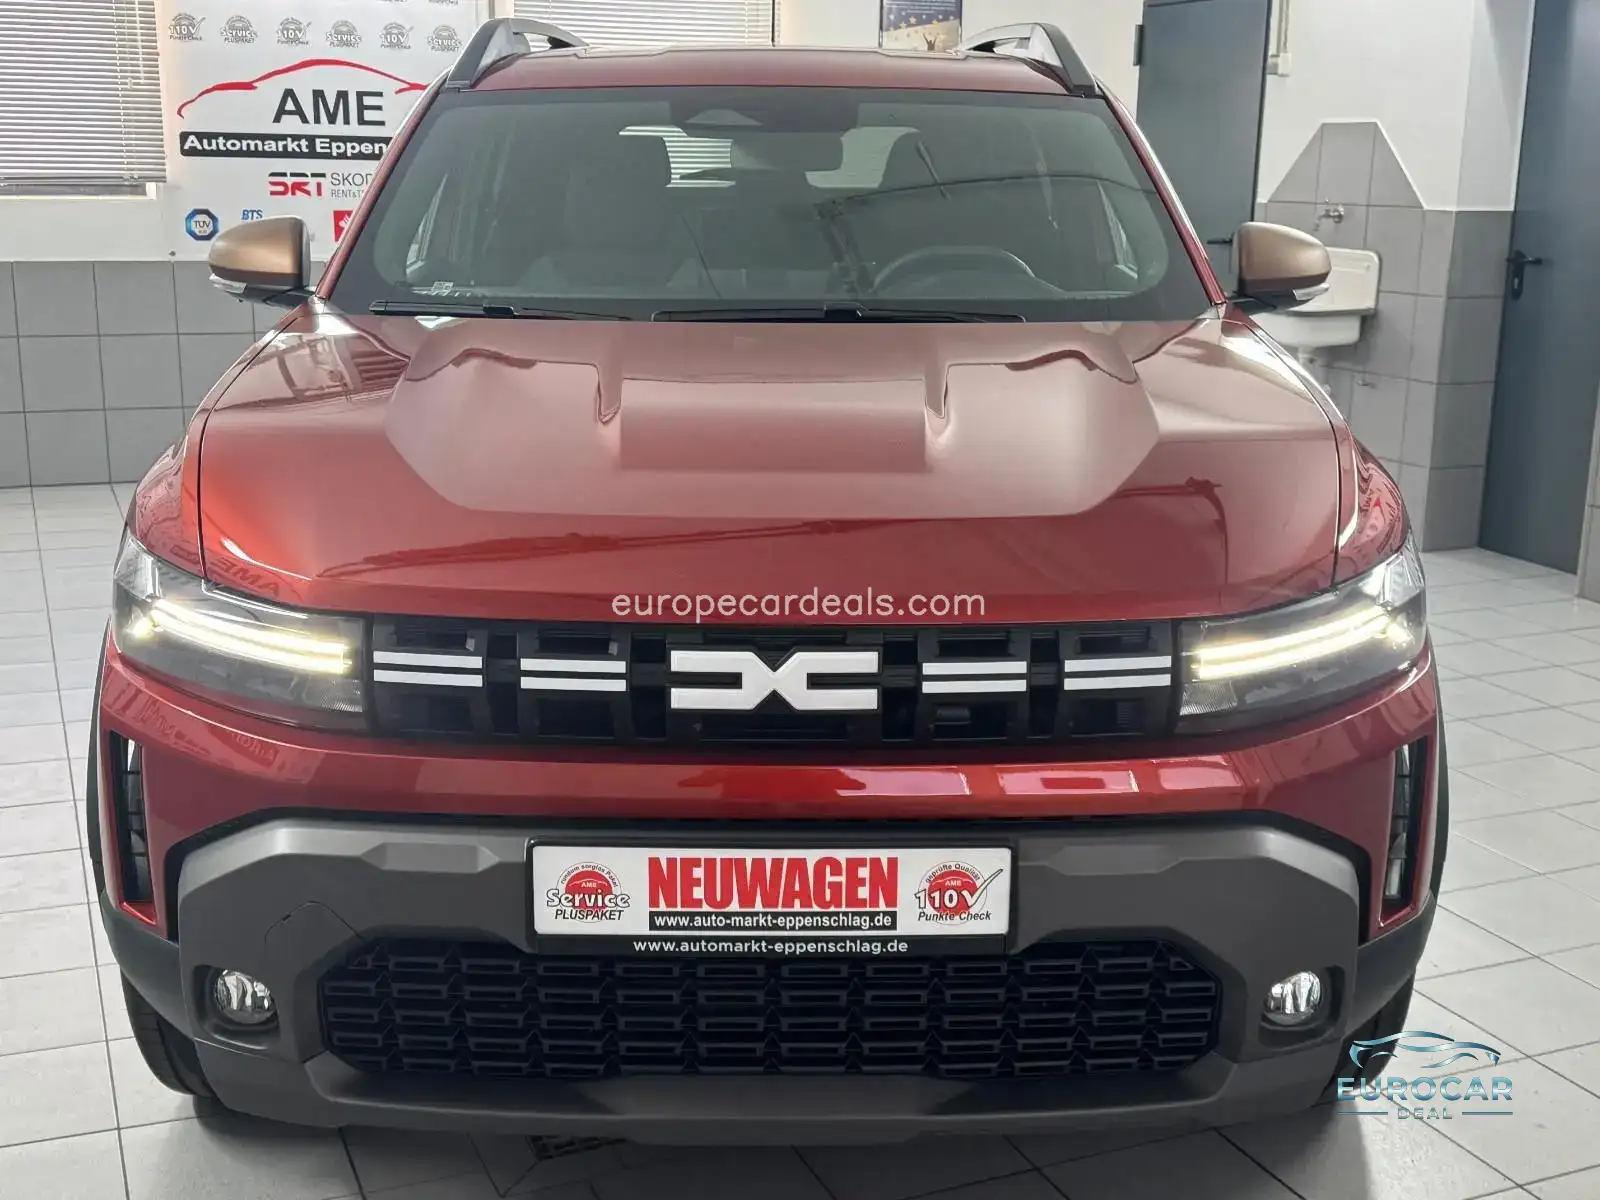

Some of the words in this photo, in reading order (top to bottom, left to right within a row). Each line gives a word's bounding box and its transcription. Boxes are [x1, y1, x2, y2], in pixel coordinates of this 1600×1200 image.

[272, 88, 386, 126] AME
[183, 134, 309, 153] Automarkt
[315, 138, 390, 157] Eppen
[268, 172, 326, 196] SRT
[242, 209, 263, 220] BTS
[648, 857, 898, 910] NEUWAGEN
[546, 888, 631, 908] Service
[555, 909, 624, 920] PLUSPAKET
[654, 913, 892, 930] www.auto-markt-eppenschlag.de
[918, 911, 956, 921] Punkte
[959, 910, 992, 921] Check
[633, 938, 908, 956] www.automarkt-eppenschlag.de
